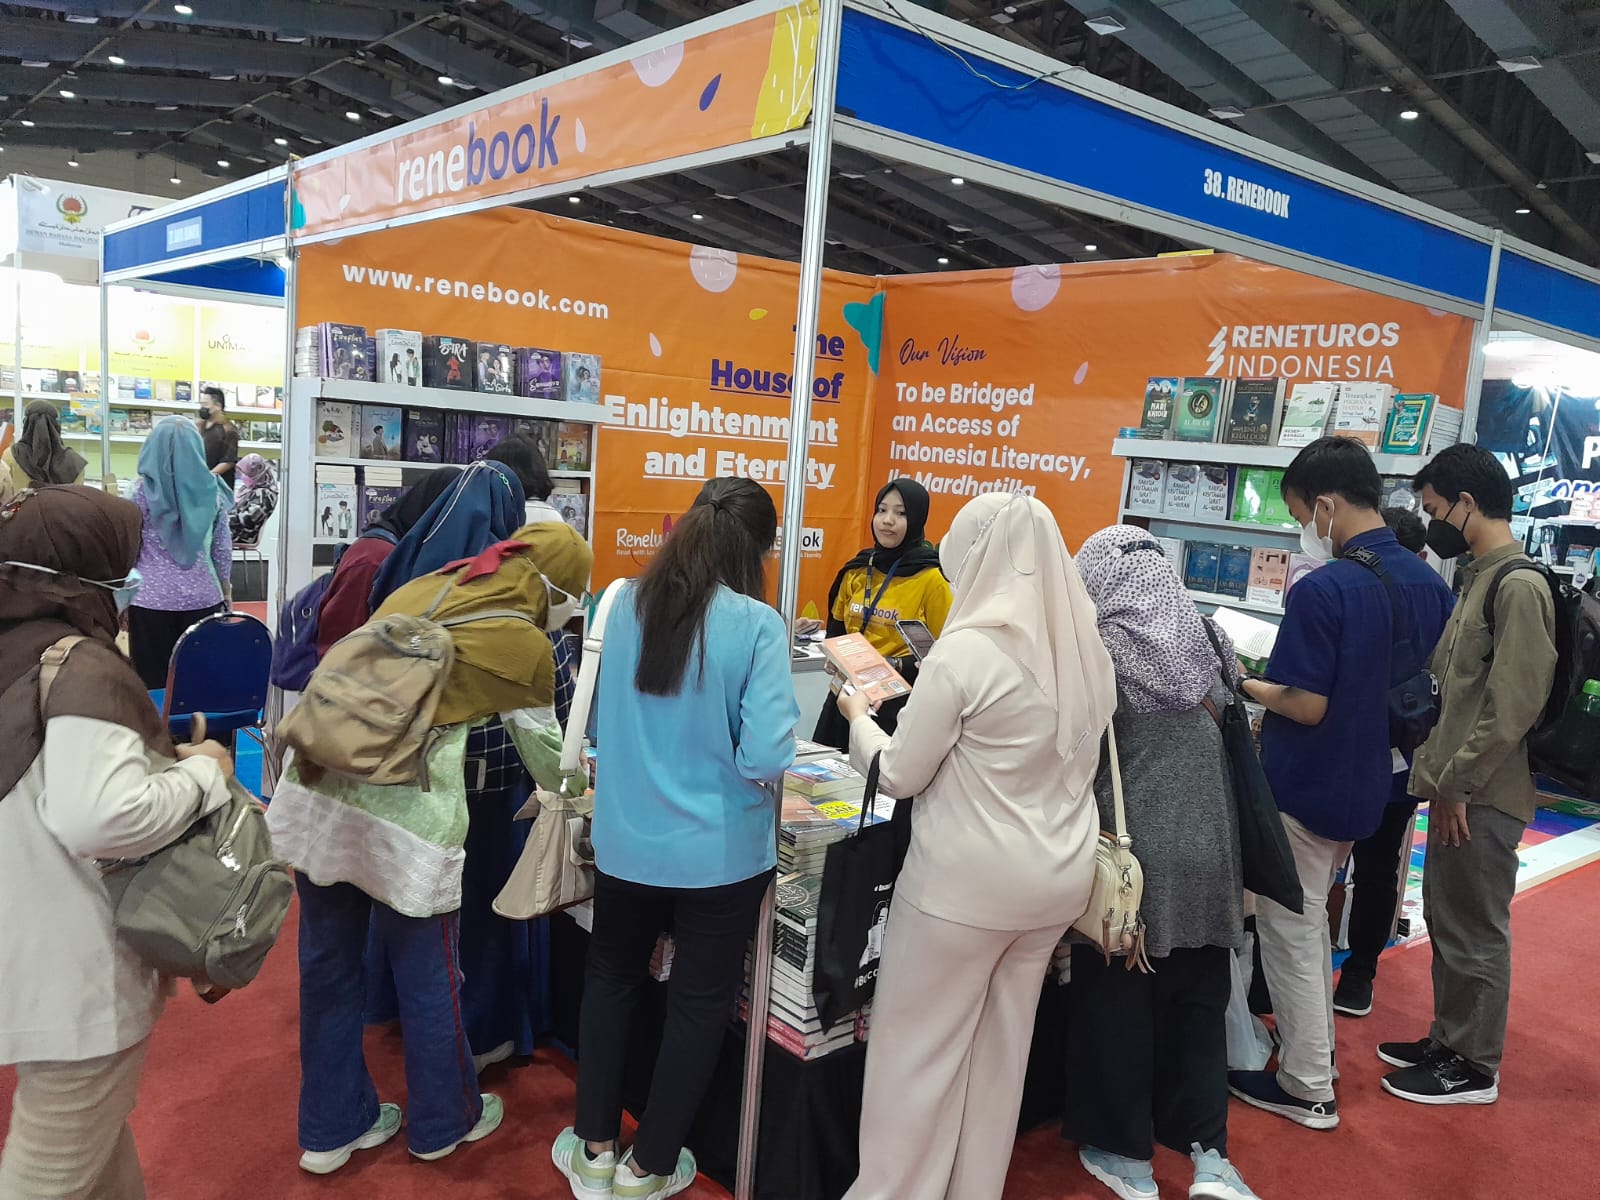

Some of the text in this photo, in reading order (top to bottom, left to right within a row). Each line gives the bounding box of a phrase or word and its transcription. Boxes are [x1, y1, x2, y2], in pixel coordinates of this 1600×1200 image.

[397, 96, 562, 204] renebook
[1203, 168, 1291, 219] 38. RENEBOOK
[342, 263, 609, 320] www.renebook.com
[792, 324, 845, 357] he
[899, 334, 988, 367] Our Vision
[1231, 322, 1401, 348] RENETUROS
[1228, 354, 1395, 379] INDONESIA
[812, 372, 845, 399] of
[896, 381, 1035, 413] To be Bridged
[604, 395, 838, 438] Enlightenmnt
[892, 412, 1021, 437] an Access of
[643, 448, 836, 490] and Eterty
[890, 440, 1091, 481] Indonesia Literacy,
[850, 602, 899, 621] renbook
